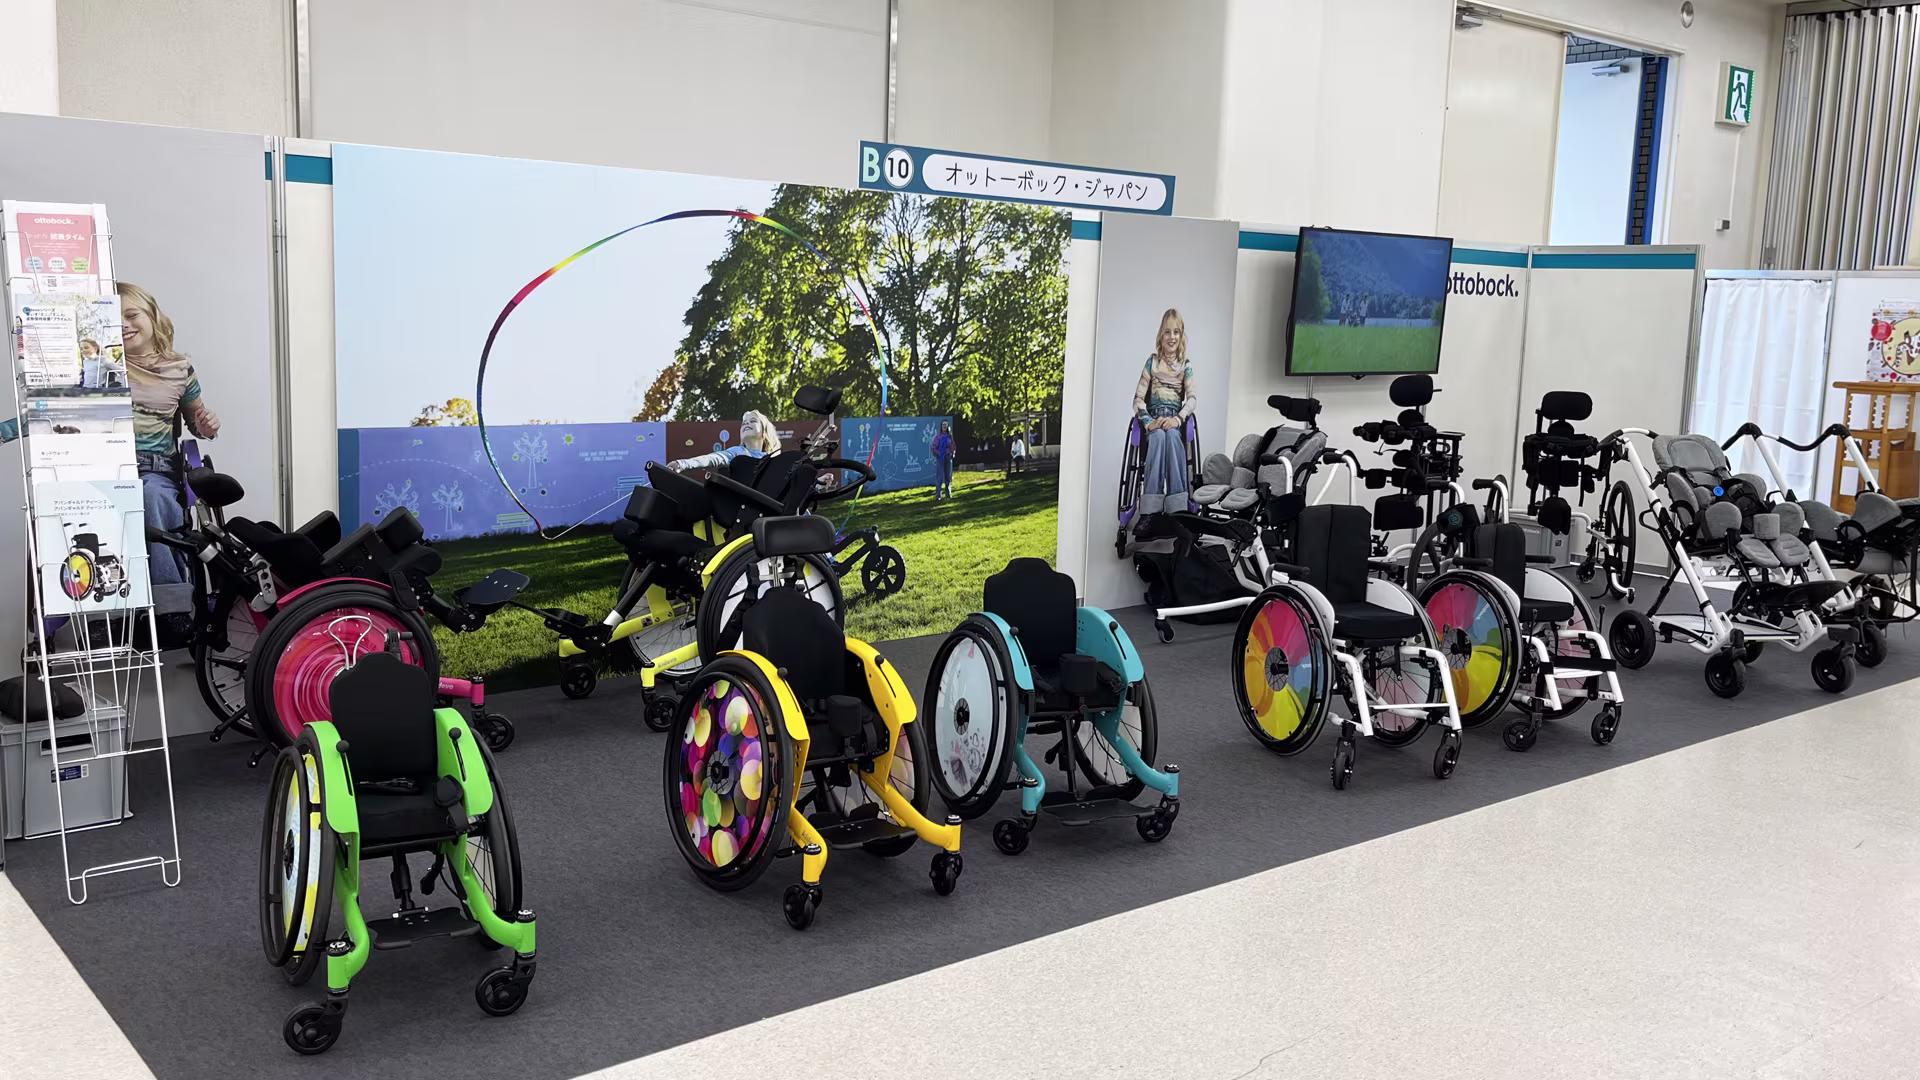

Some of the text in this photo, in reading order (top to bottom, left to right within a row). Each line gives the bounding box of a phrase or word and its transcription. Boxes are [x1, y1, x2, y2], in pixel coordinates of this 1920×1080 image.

[862, 146, 1148, 202] B 10 オットーボック・ジャパン
